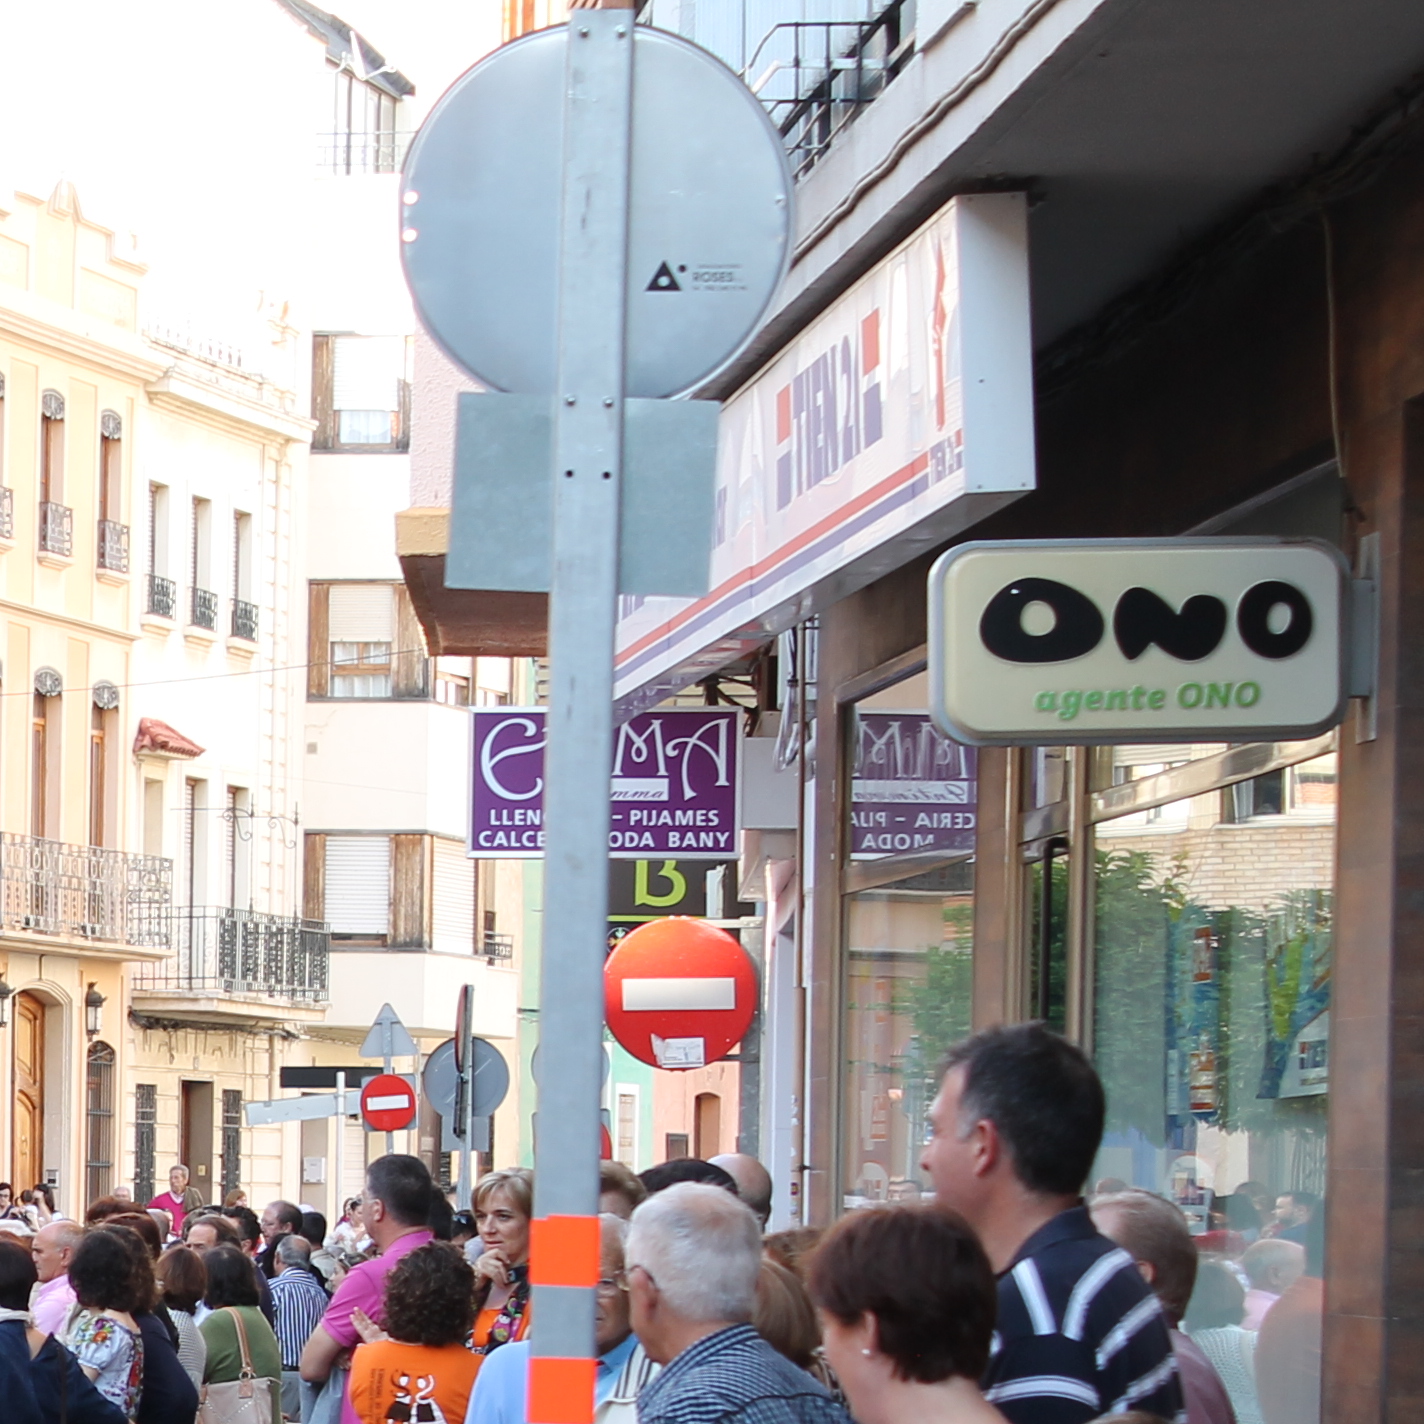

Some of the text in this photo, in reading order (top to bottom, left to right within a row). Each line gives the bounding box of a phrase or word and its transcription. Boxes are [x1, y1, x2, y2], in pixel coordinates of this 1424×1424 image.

[692, 271, 734, 283] ROSES
[979, 576, 1314, 664] ONO
[1033, 681, 1262, 721] agente ONO
[490, 809, 546, 826] LLEN
[629, 809, 720, 826] PIJAMES
[608, 831, 655, 848] ODA
[668, 831, 730, 848] BANY
